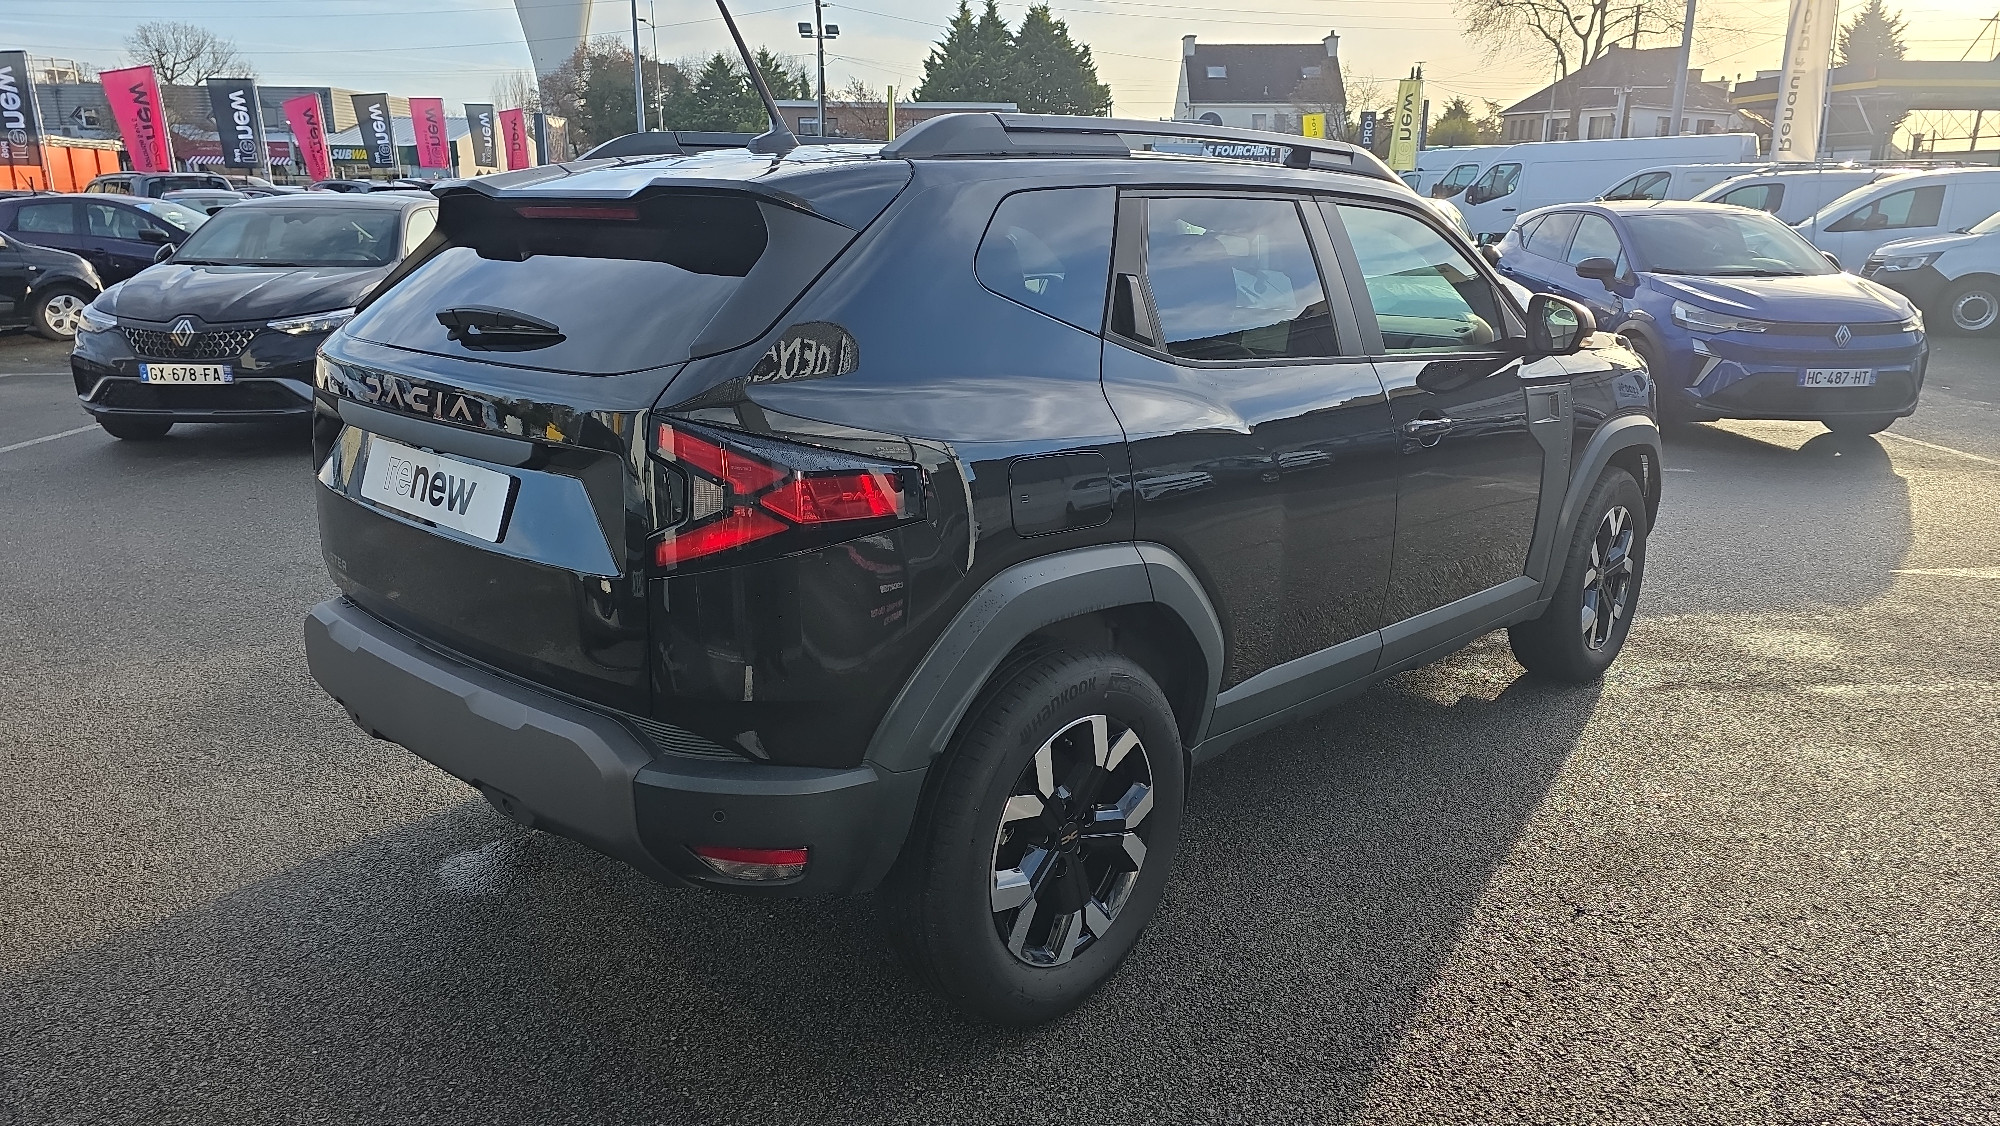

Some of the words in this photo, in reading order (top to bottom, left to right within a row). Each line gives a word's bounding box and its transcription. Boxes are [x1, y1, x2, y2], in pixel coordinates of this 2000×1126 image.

[1363, 114, 1374, 145] PRO+
[332, 149, 368, 160] SUBWA
[150, 367, 221, 382] GX-678-FA
[1806, 371, 1869, 385] HC-487-HT
[366, 376, 472, 421] DACIA
[383, 456, 478, 515] renew
